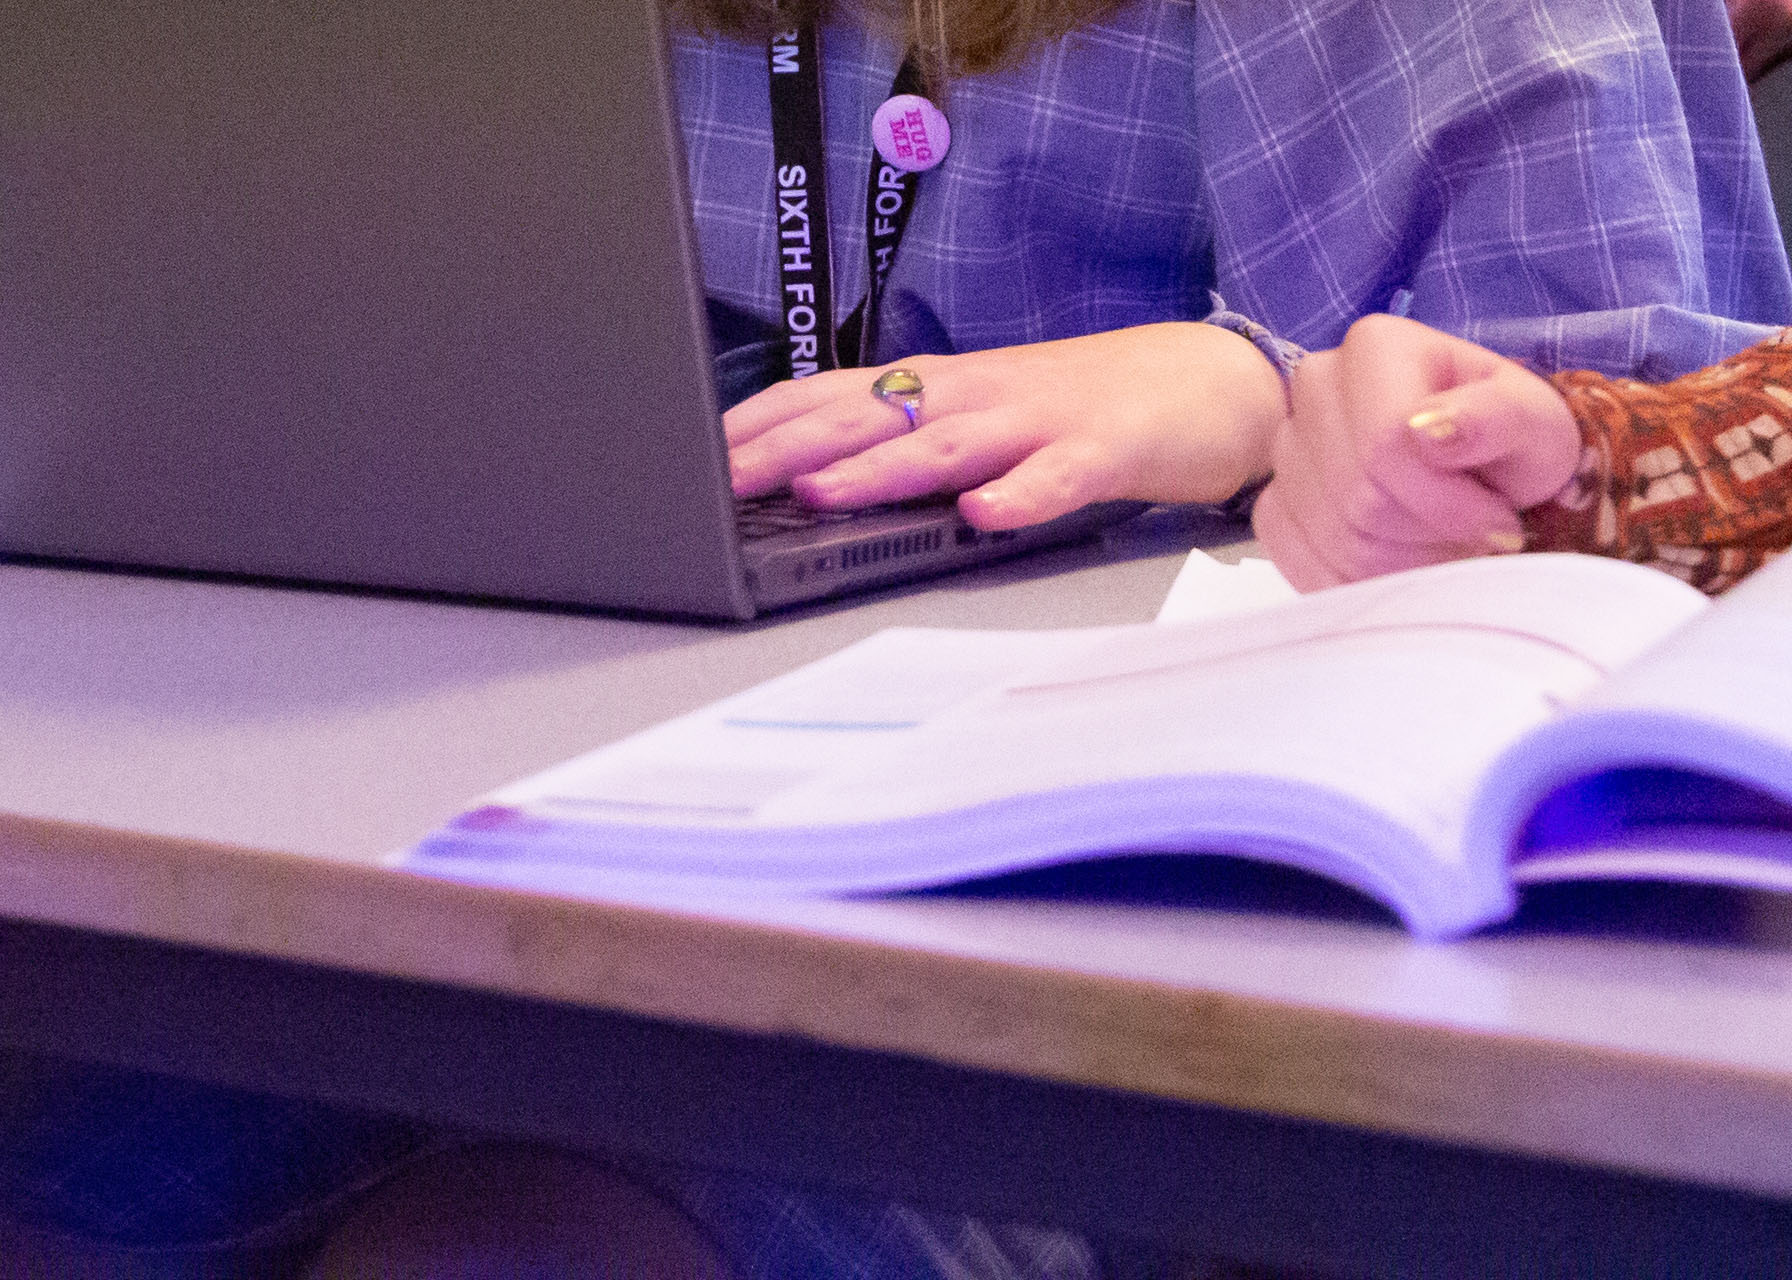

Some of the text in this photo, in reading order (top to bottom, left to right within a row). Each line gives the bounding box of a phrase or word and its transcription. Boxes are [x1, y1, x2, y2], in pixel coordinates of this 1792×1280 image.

[889, 117, 913, 160] ME
[905, 107, 934, 163] HUG
[874, 165, 905, 238] FOR
[778, 164, 819, 380] SIXTH FORM
